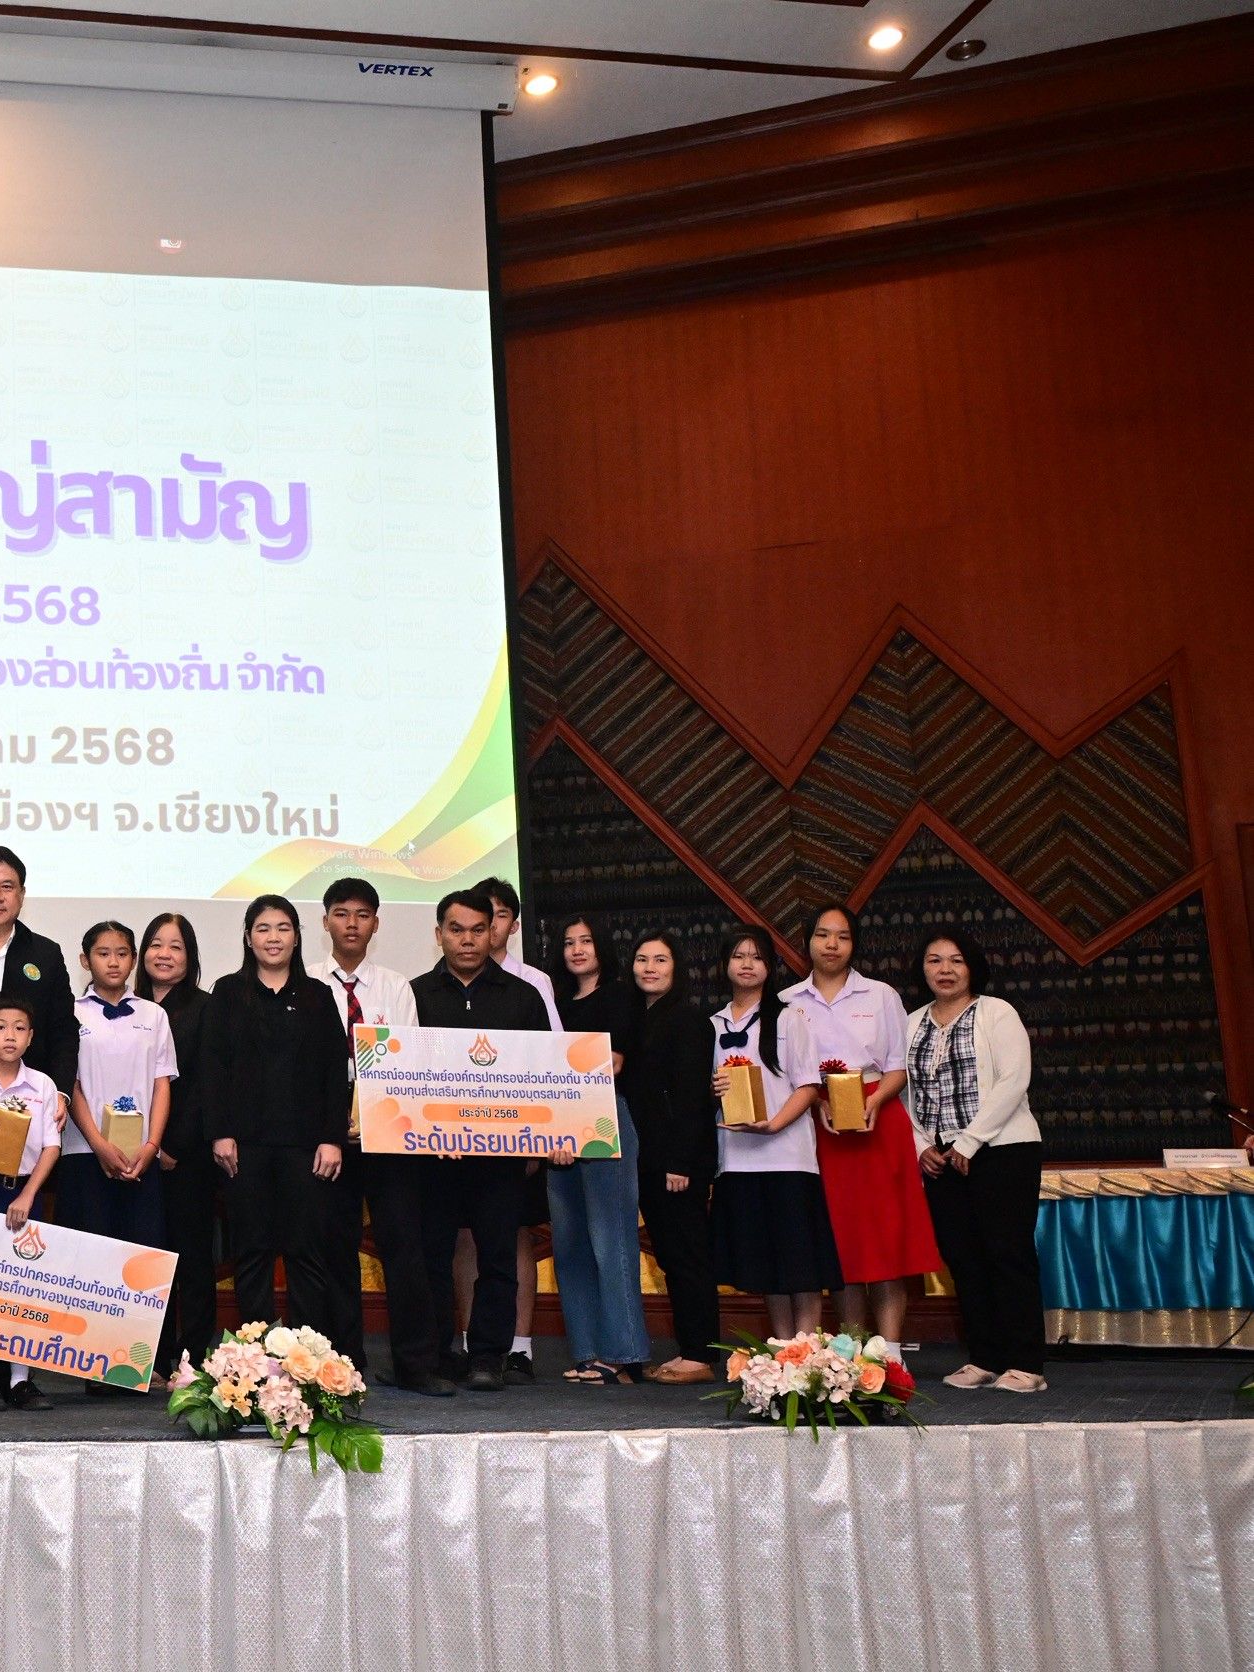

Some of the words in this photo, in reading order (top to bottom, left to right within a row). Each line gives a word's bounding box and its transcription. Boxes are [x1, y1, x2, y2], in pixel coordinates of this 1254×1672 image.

[358, 62, 435, 77] VERTEX
[236, 651, 325, 694] จำกัด
[50, 726, 175, 766] 2568
[112, 790, 340, 838] จ.เชียงใหม่
[309, 847, 355, 859] ctivate
[584, 1071, 612, 1085] จำกัด
[386, 1084, 581, 1102] มอบทุนส่งเสริมการศึกษาของบุตรสมาชิก
[458, 1107, 492, 1118] ประจำปี
[494, 1109, 519, 1119] 2568
[403, 1125, 577, 1154] ระดับมัธยมศึกษา
[133, 1290, 165, 1310] จำกัด
[20, 1308, 50, 1324] 2568
